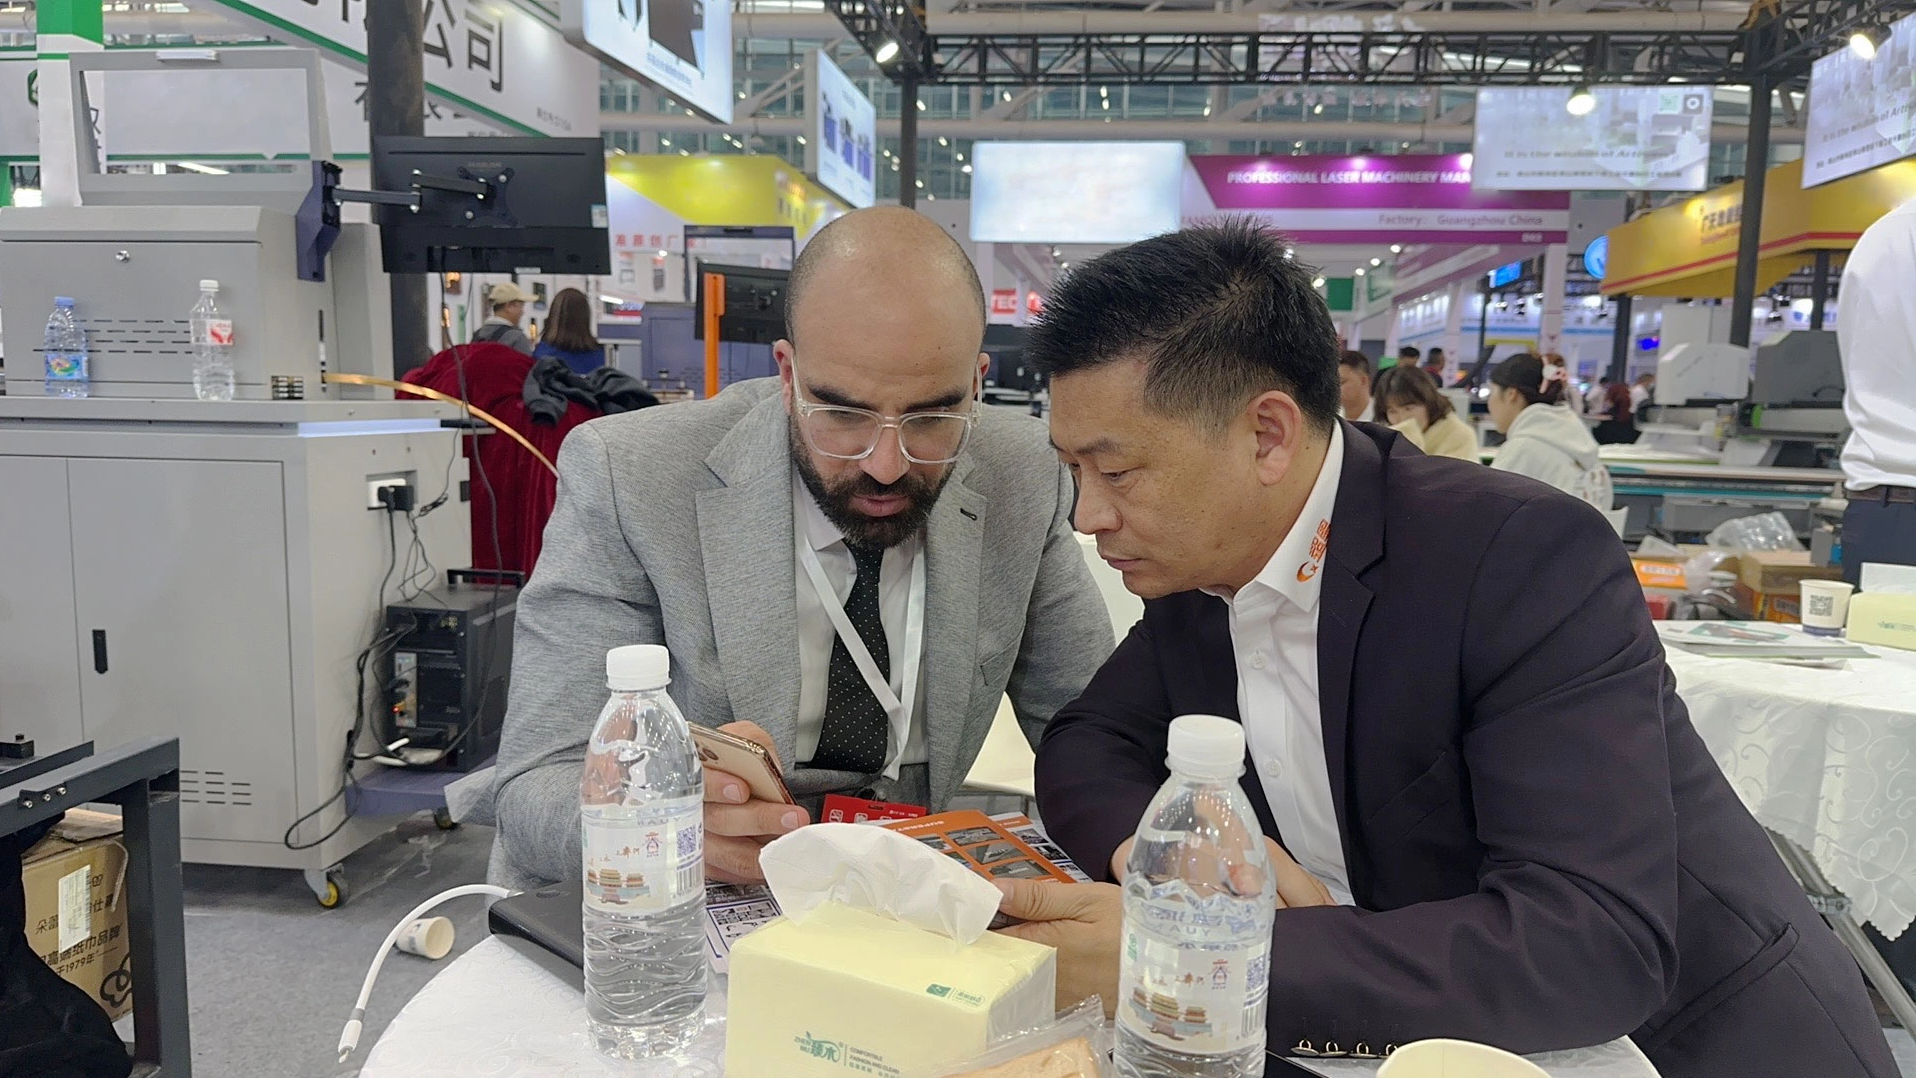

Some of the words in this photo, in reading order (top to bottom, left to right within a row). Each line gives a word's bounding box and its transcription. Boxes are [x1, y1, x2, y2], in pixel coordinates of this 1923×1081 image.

[1227, 171, 1318, 184] PROFESSIONAL
[1320, 171, 1360, 184] LASER
[1361, 171, 1439, 184] MACHINERY
[1437, 214, 1506, 227] Guangzhou
[1508, 214, 1544, 225] China
